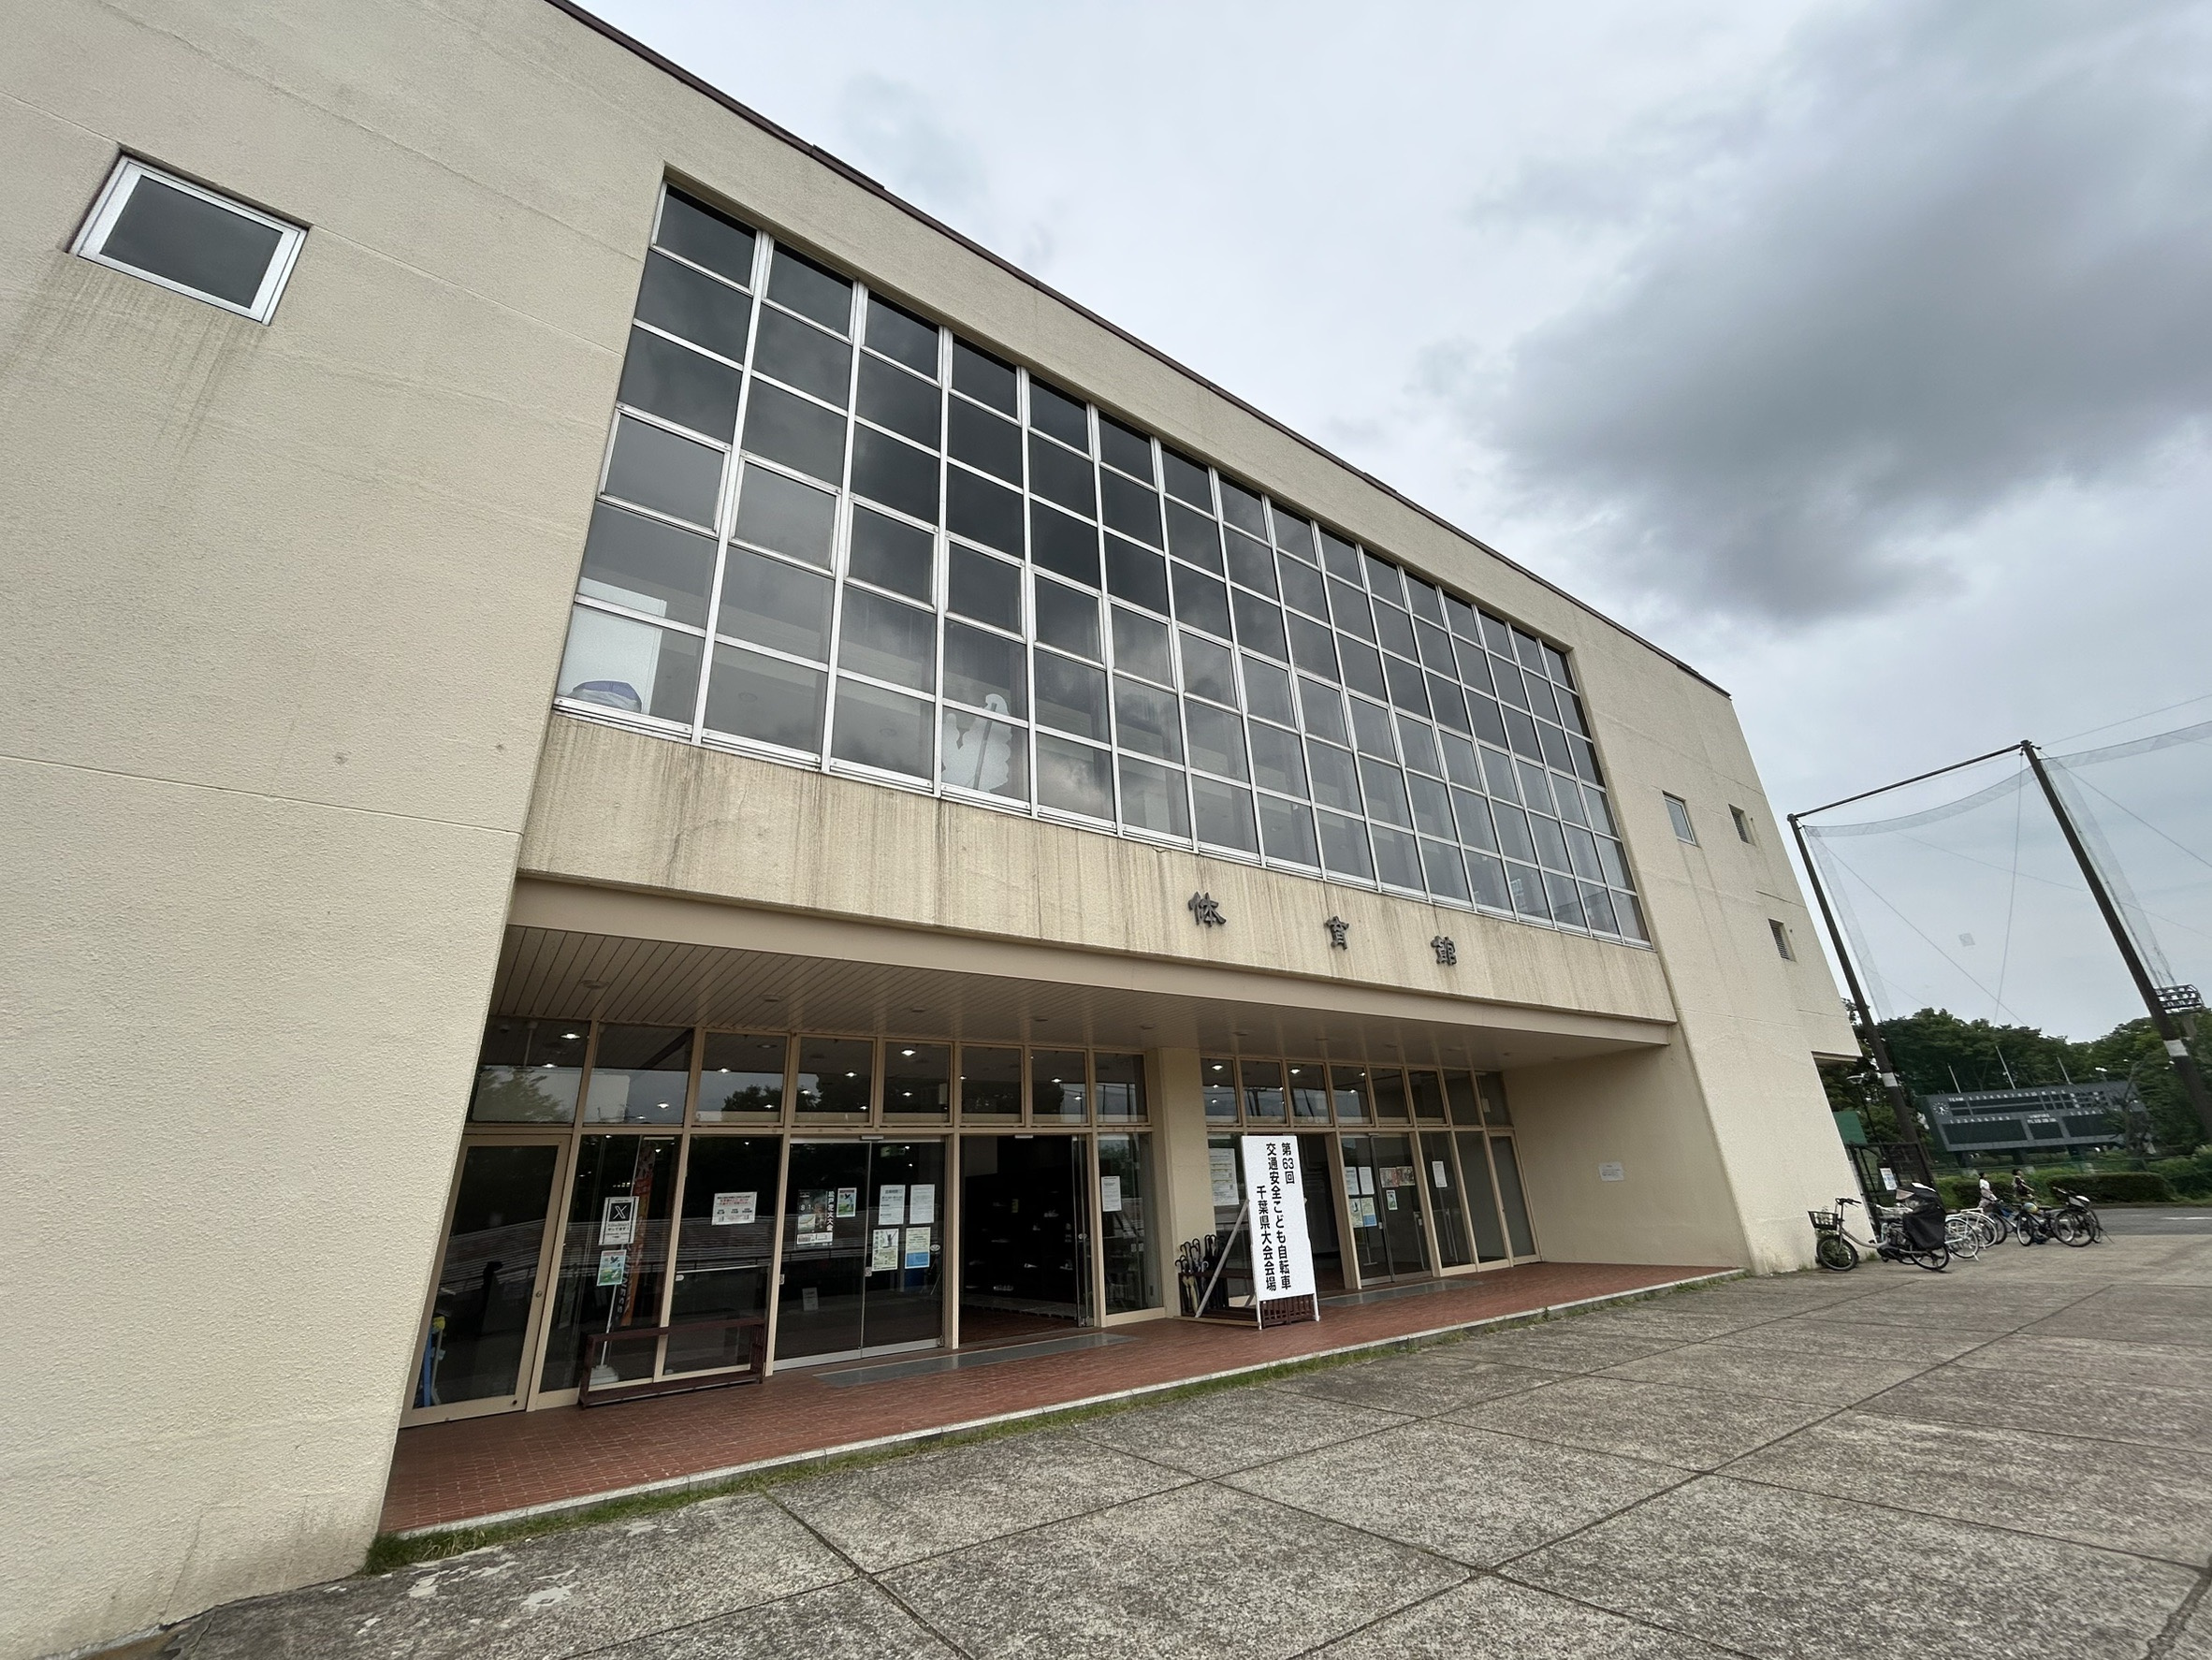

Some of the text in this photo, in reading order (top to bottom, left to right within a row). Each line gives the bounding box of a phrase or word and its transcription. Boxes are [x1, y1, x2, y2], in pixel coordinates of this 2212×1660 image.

[1188, 891, 1457, 966] 体育館
[1281, 1143, 1295, 1185] 第63回
[1256, 1185, 1276, 1291] 千葉県大会会場
[1266, 1143, 1291, 1290] 交通安全こども自転車
